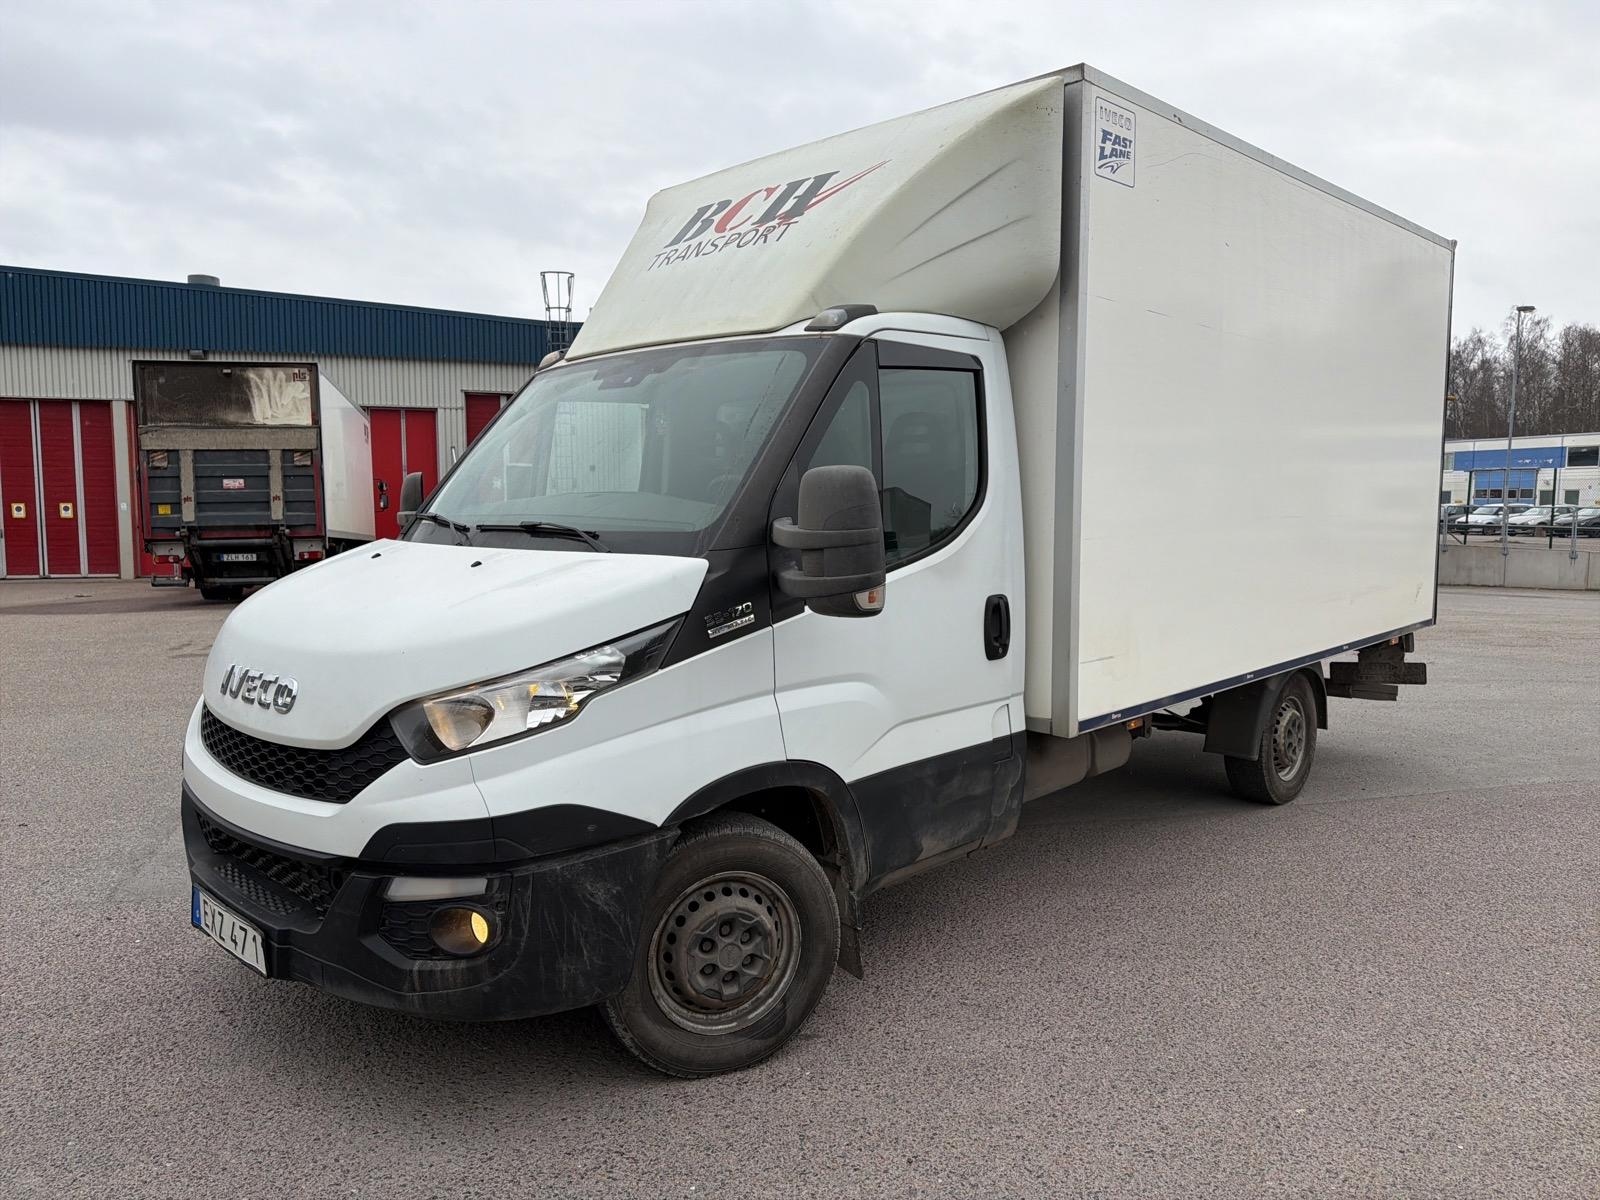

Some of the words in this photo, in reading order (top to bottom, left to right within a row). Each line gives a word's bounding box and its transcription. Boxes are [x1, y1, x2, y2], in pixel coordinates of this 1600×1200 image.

[1099, 106, 1132, 131] IVECO
[1099, 145, 1132, 161] LANE
[1101, 127, 1133, 149] FAST
[647, 219, 799, 271] TRANSPORT
[219, 663, 298, 715] IVECO
[203, 899, 226, 943] EXZ
[231, 921, 259, 964] 471
